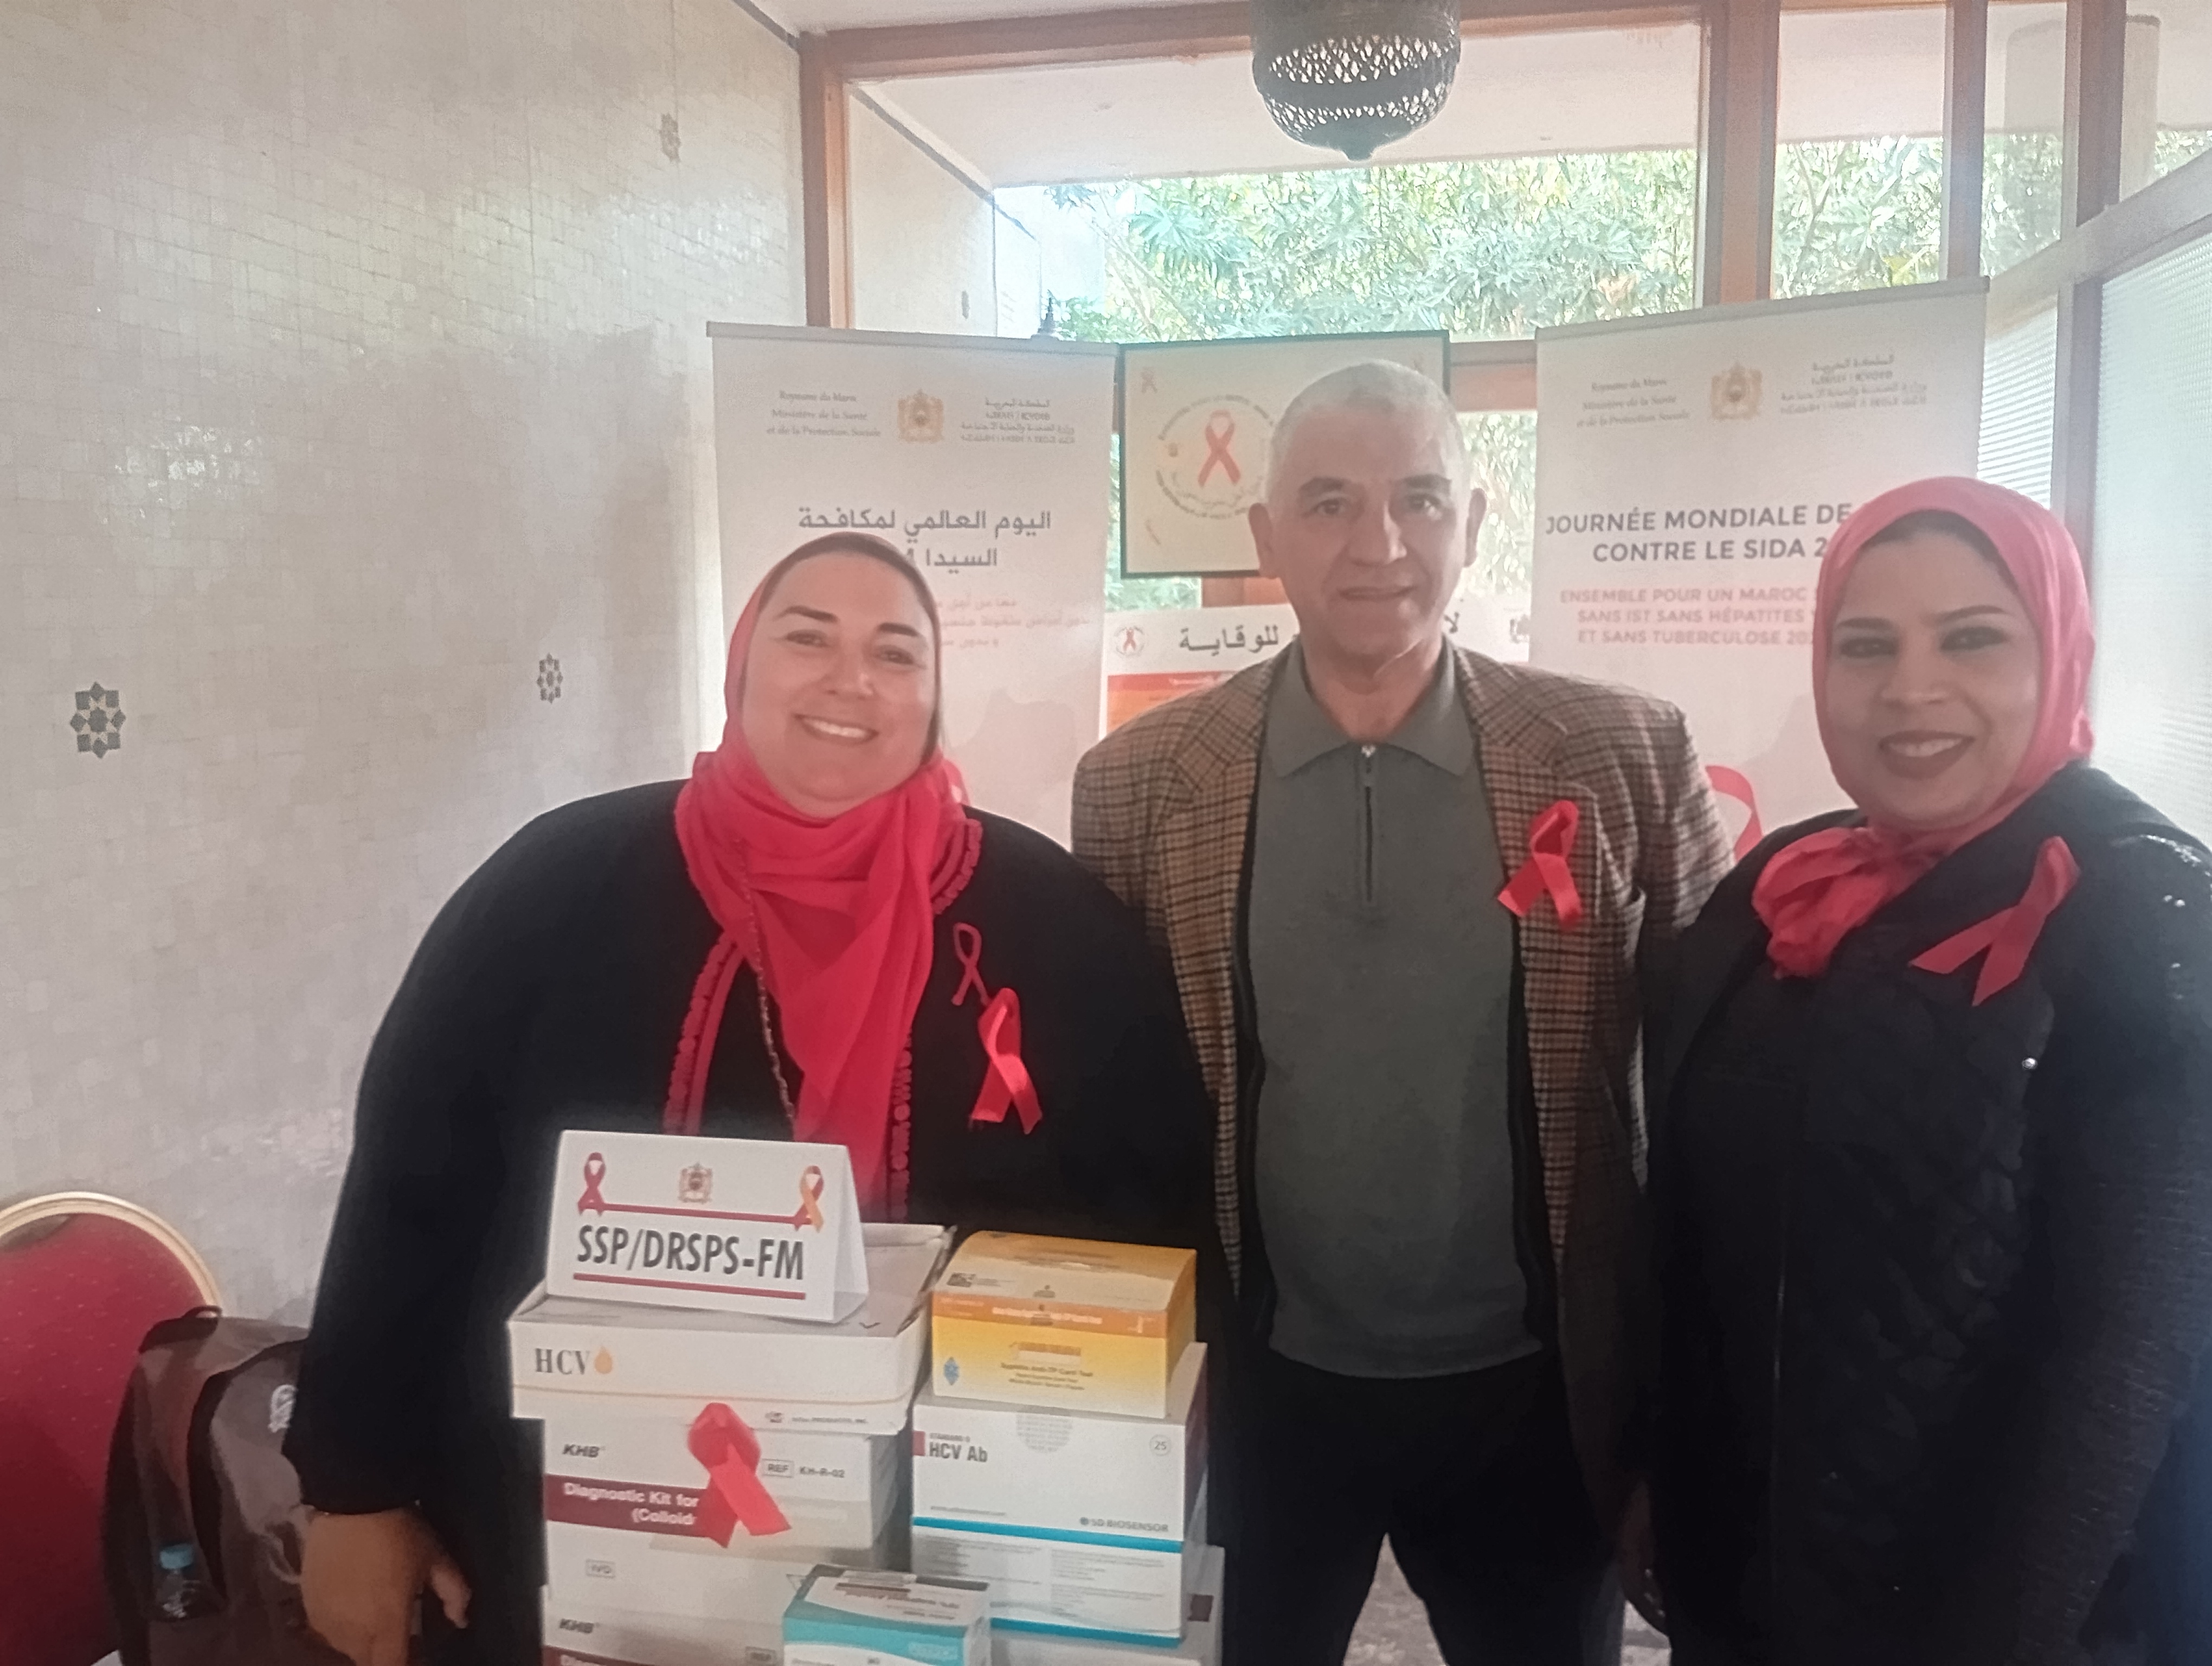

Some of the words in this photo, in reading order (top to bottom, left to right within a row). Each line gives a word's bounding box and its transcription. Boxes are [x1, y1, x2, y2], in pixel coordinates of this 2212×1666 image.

[799, 507, 895, 529] لمكافحة
[904, 510, 986, 543] العالمي
[994, 511, 1051, 539] اليوم
[1545, 507, 1657, 534] JOURNÉE
[1664, 505, 1808, 530] MONDIALE
[1816, 503, 1853, 524] DE
[926, 548, 997, 574] السيدا
[1592, 540, 1696, 562] CONTRE
[1705, 540, 1734, 561] LE
[1743, 538, 1806, 559] SIDA
[1560, 588, 1647, 603] ENSEMBLE
[1652, 588, 1701, 603] POUR
[1707, 588, 1733, 602] UN
[1739, 587, 1806, 602] MAROC
[1578, 609, 1621, 623] SANS
[1626, 609, 1650, 623] IST
[1656, 608, 1702, 623] SANS
[1709, 606, 1804, 623] HÉPATITES
[1180, 625, 1278, 656] للوقاية
[1578, 630, 1597, 644] ET
[1602, 630, 1647, 644] SANS
[1653, 630, 1781, 645] TUBERCULOSE
[577, 1225, 803, 1280] SSP/DRSPS-FM
[535, 1348, 590, 1375] HCV
[562, 1444, 599, 1458] KHB
[929, 1441, 962, 1459] HCV
[967, 1446, 988, 1463] Ab
[1154, 1440, 1167, 1450] 25
[563, 1482, 645, 1502] Diagnostic
[649, 1491, 672, 1505] Kit
[676, 1493, 700, 1507] for
[632, 1508, 697, 1526] (Colloid
[1107, 1519, 1169, 1532] BIOSENSOR
